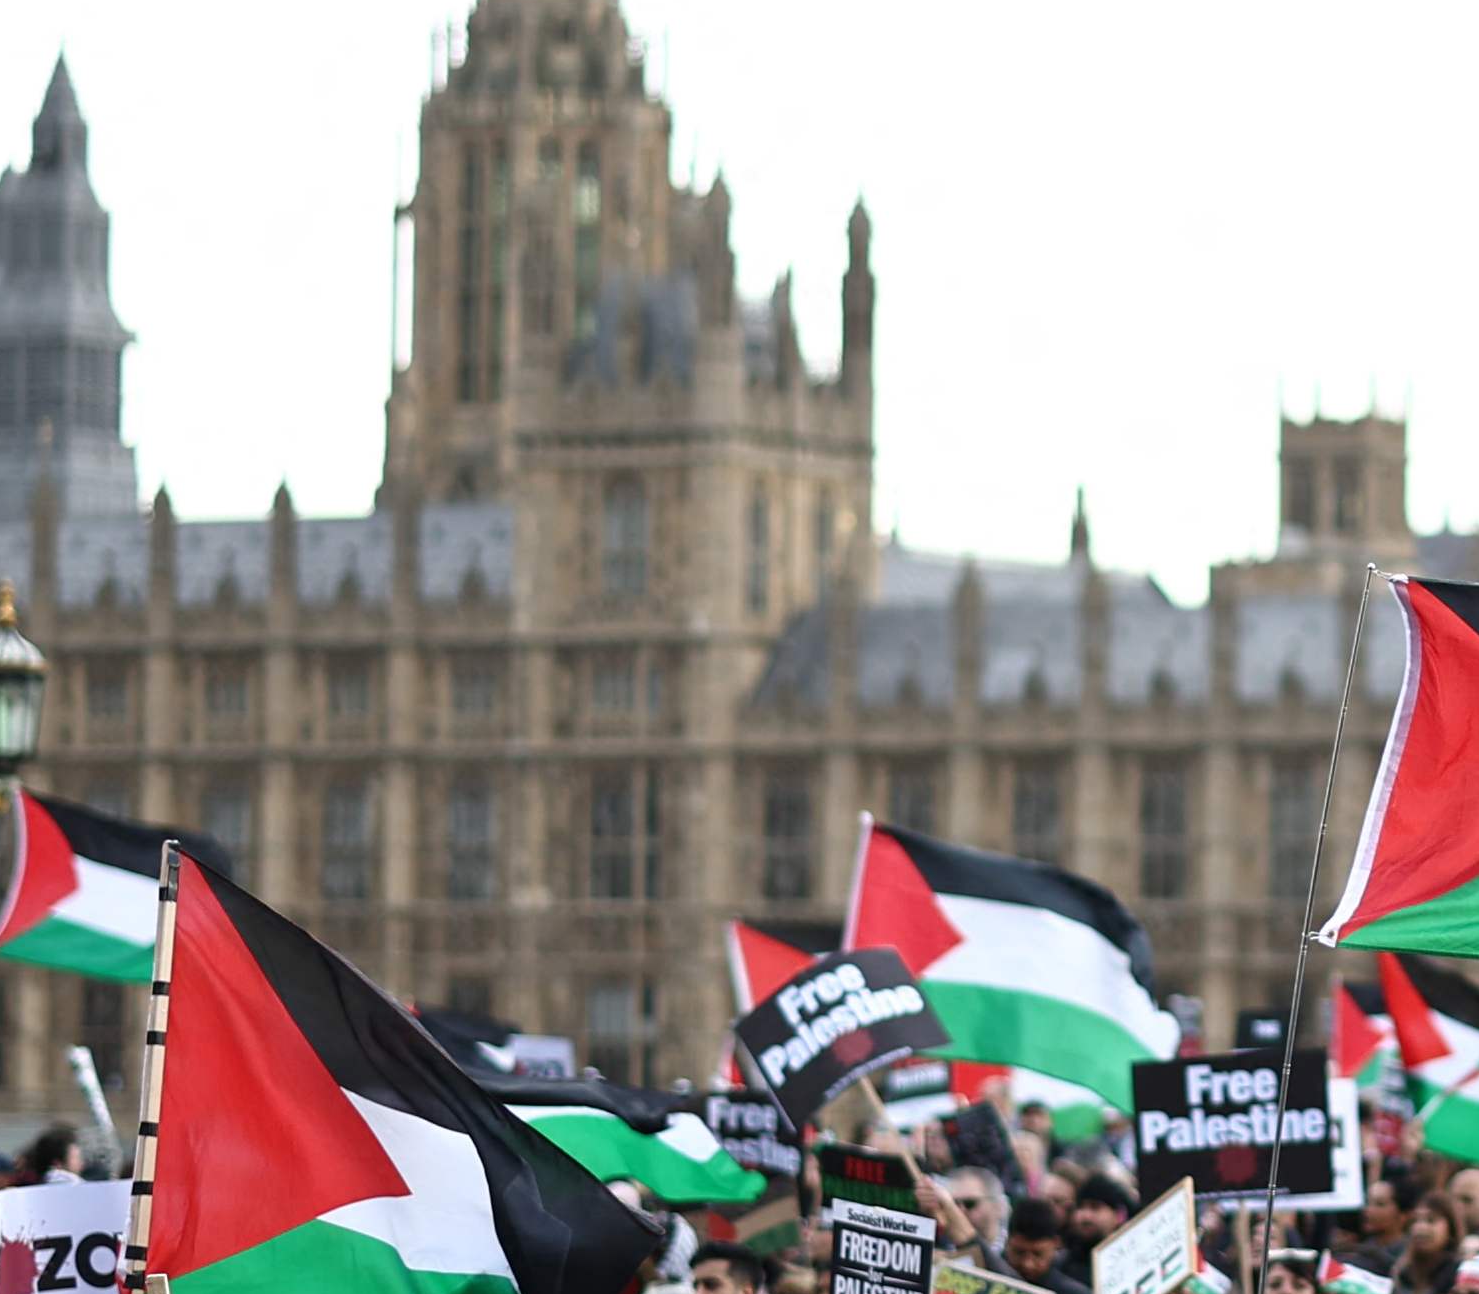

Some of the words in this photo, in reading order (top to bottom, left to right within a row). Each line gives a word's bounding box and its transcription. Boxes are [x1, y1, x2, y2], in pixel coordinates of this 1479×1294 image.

[776, 962, 867, 1028] Free
[761, 984, 925, 1088] Palestine
[1186, 1063, 1278, 1106] Free
[707, 1096, 778, 1132] Free
[1139, 1102, 1327, 1152] Palestine
[840, 1229, 921, 1275] FREEDOM
